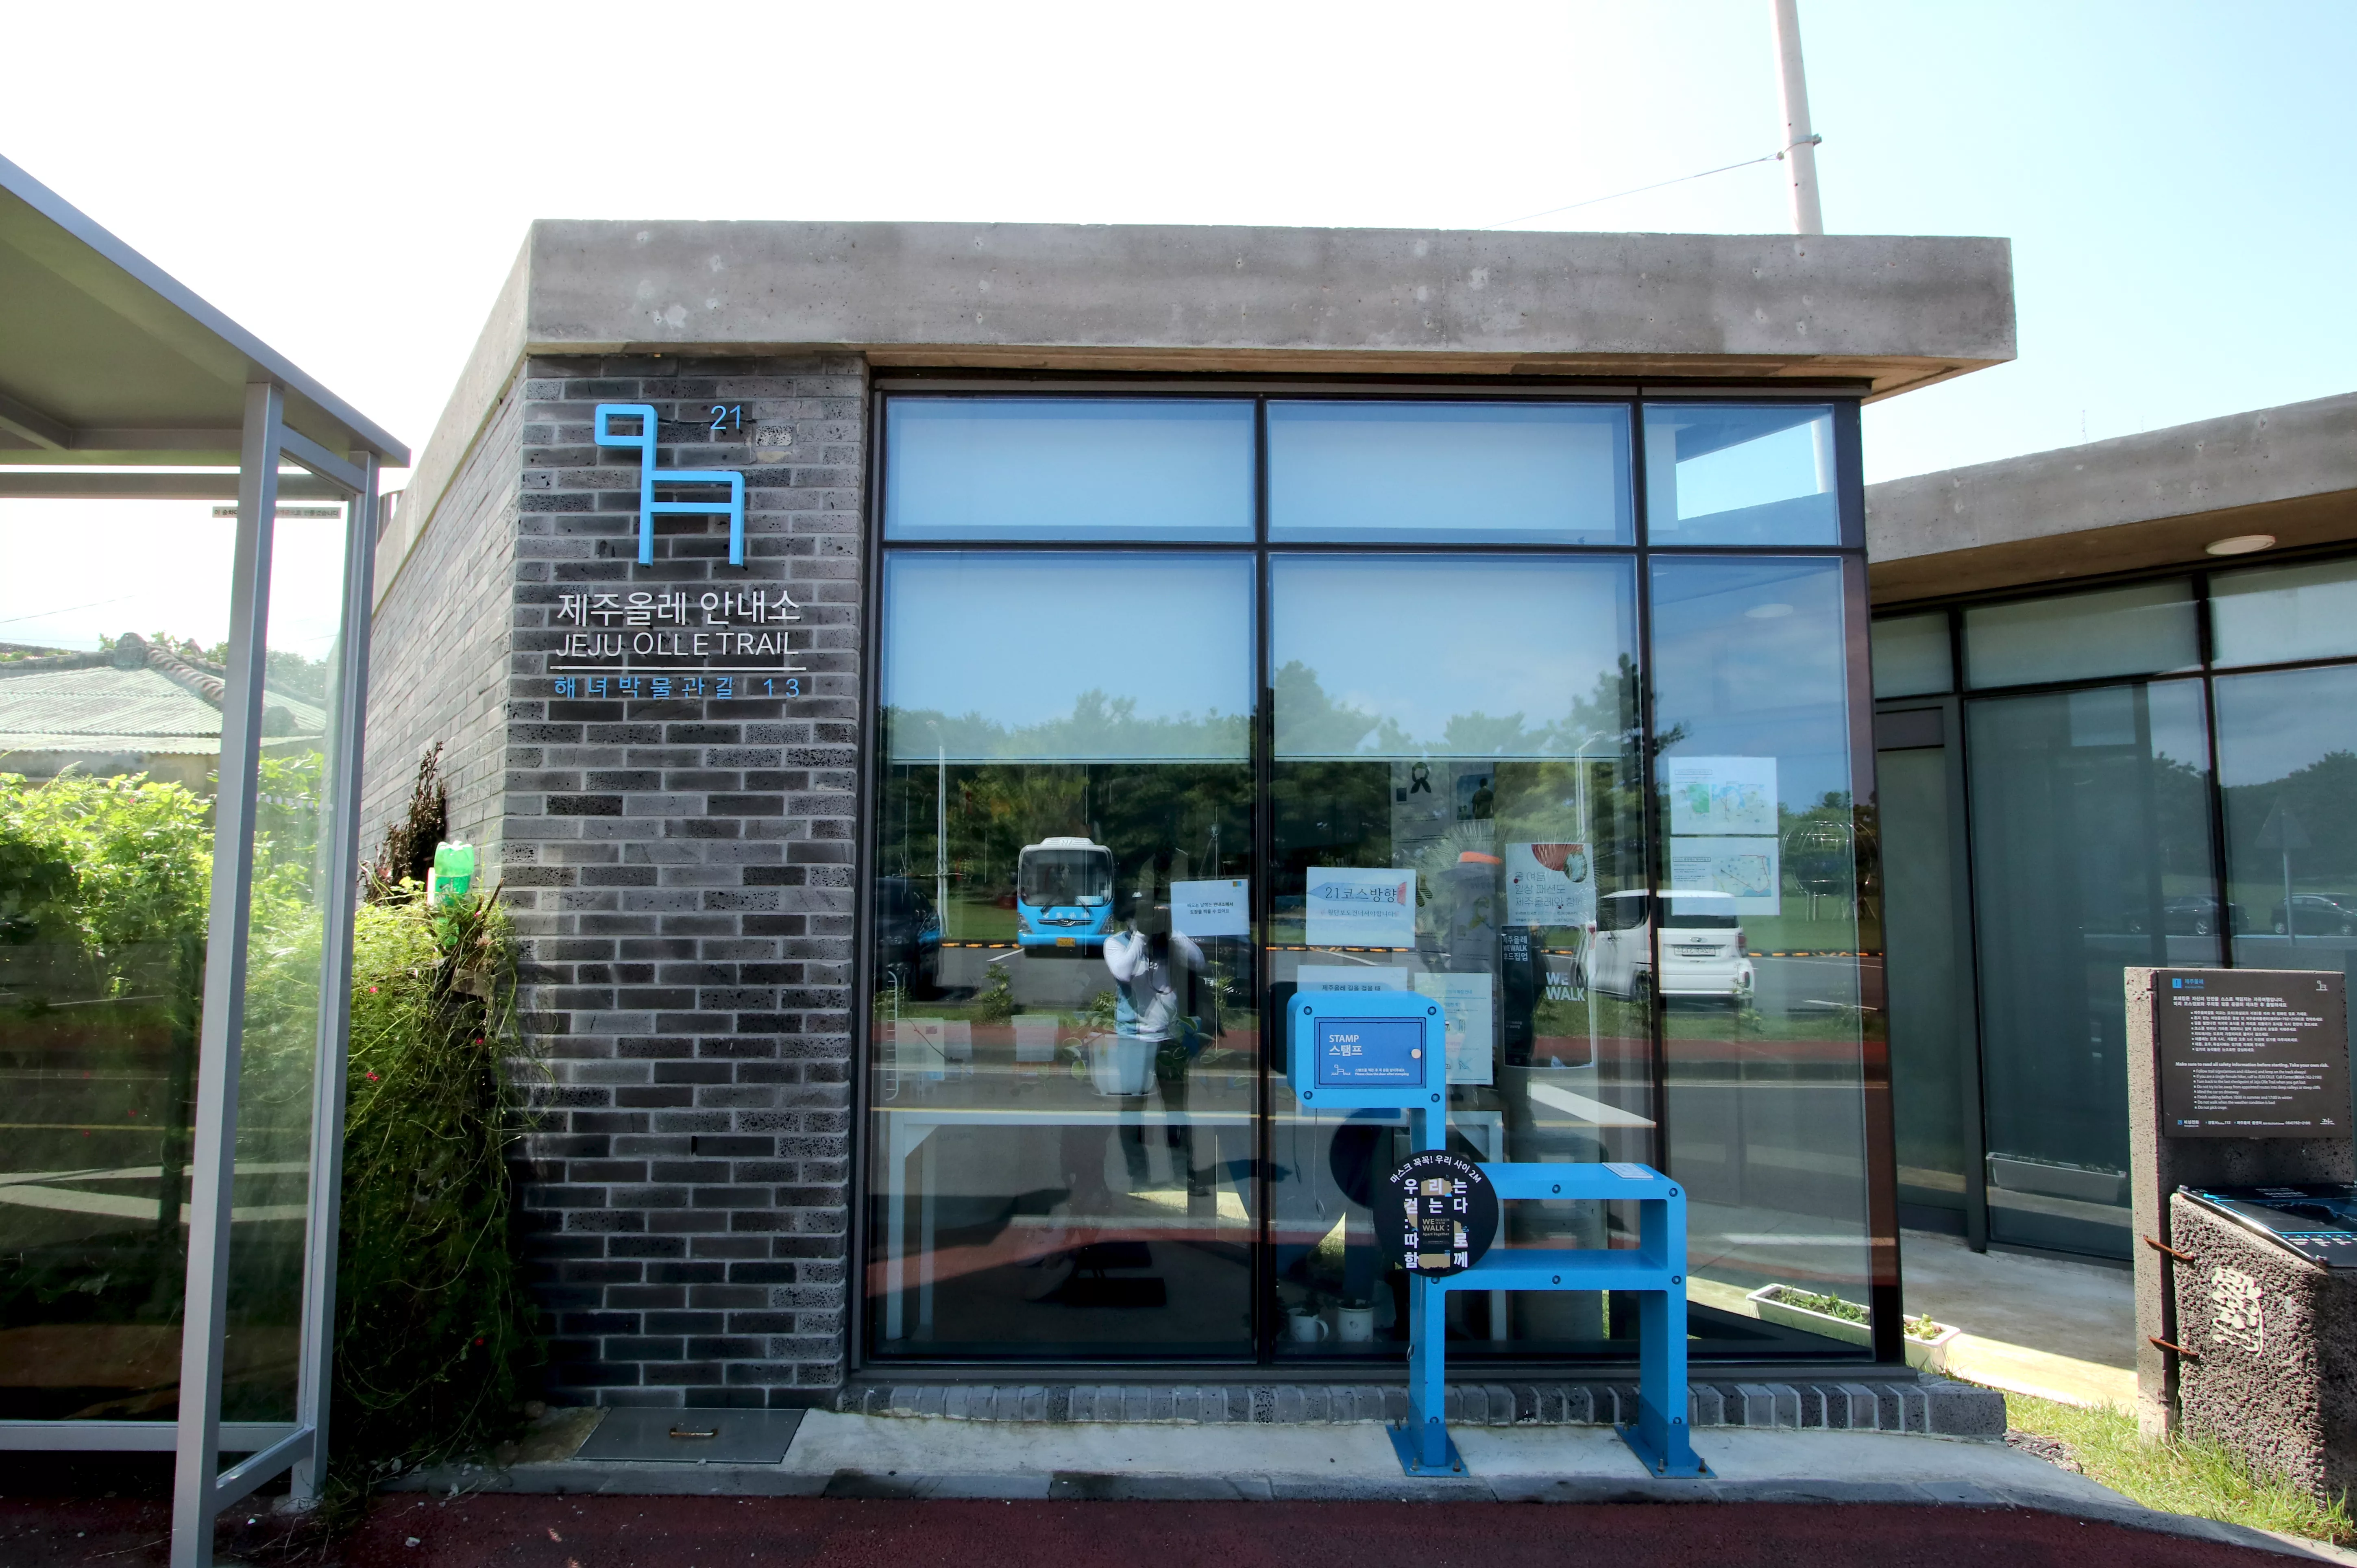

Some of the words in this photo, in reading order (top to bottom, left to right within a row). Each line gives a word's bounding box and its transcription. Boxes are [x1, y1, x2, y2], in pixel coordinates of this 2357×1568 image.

[710, 405, 741, 430] 21
[557, 591, 686, 627] 제주올레
[700, 590, 801, 625] 안내소
[556, 634, 622, 657] JEJU
[633, 632, 710, 656] OLLE
[716, 632, 799, 656] TRAIL
[1515, 871, 1523, 882] 올
[1526, 871, 1545, 882] 여름
[1325, 886, 1397, 903] 21코스방향
[1515, 884, 1533, 894] 일상
[1536, 884, 1565, 894] 패션도
[1515, 897, 1564, 907] 제주올레와
[1546, 972, 1569, 986] WE
[1545, 987, 1586, 1002] WALK
[1329, 1034, 1359, 1043] STAMP
[1329, 1044, 1363, 1057] 스탬프
[1390, 1163, 1413, 1183] 마스크
[1413, 1155, 1433, 1167] 꼭꼭!
[1435, 1155, 1452, 1166] 우리
[1453, 1159, 1469, 1174] 사이
[1468, 1169, 1482, 1184] 2M
